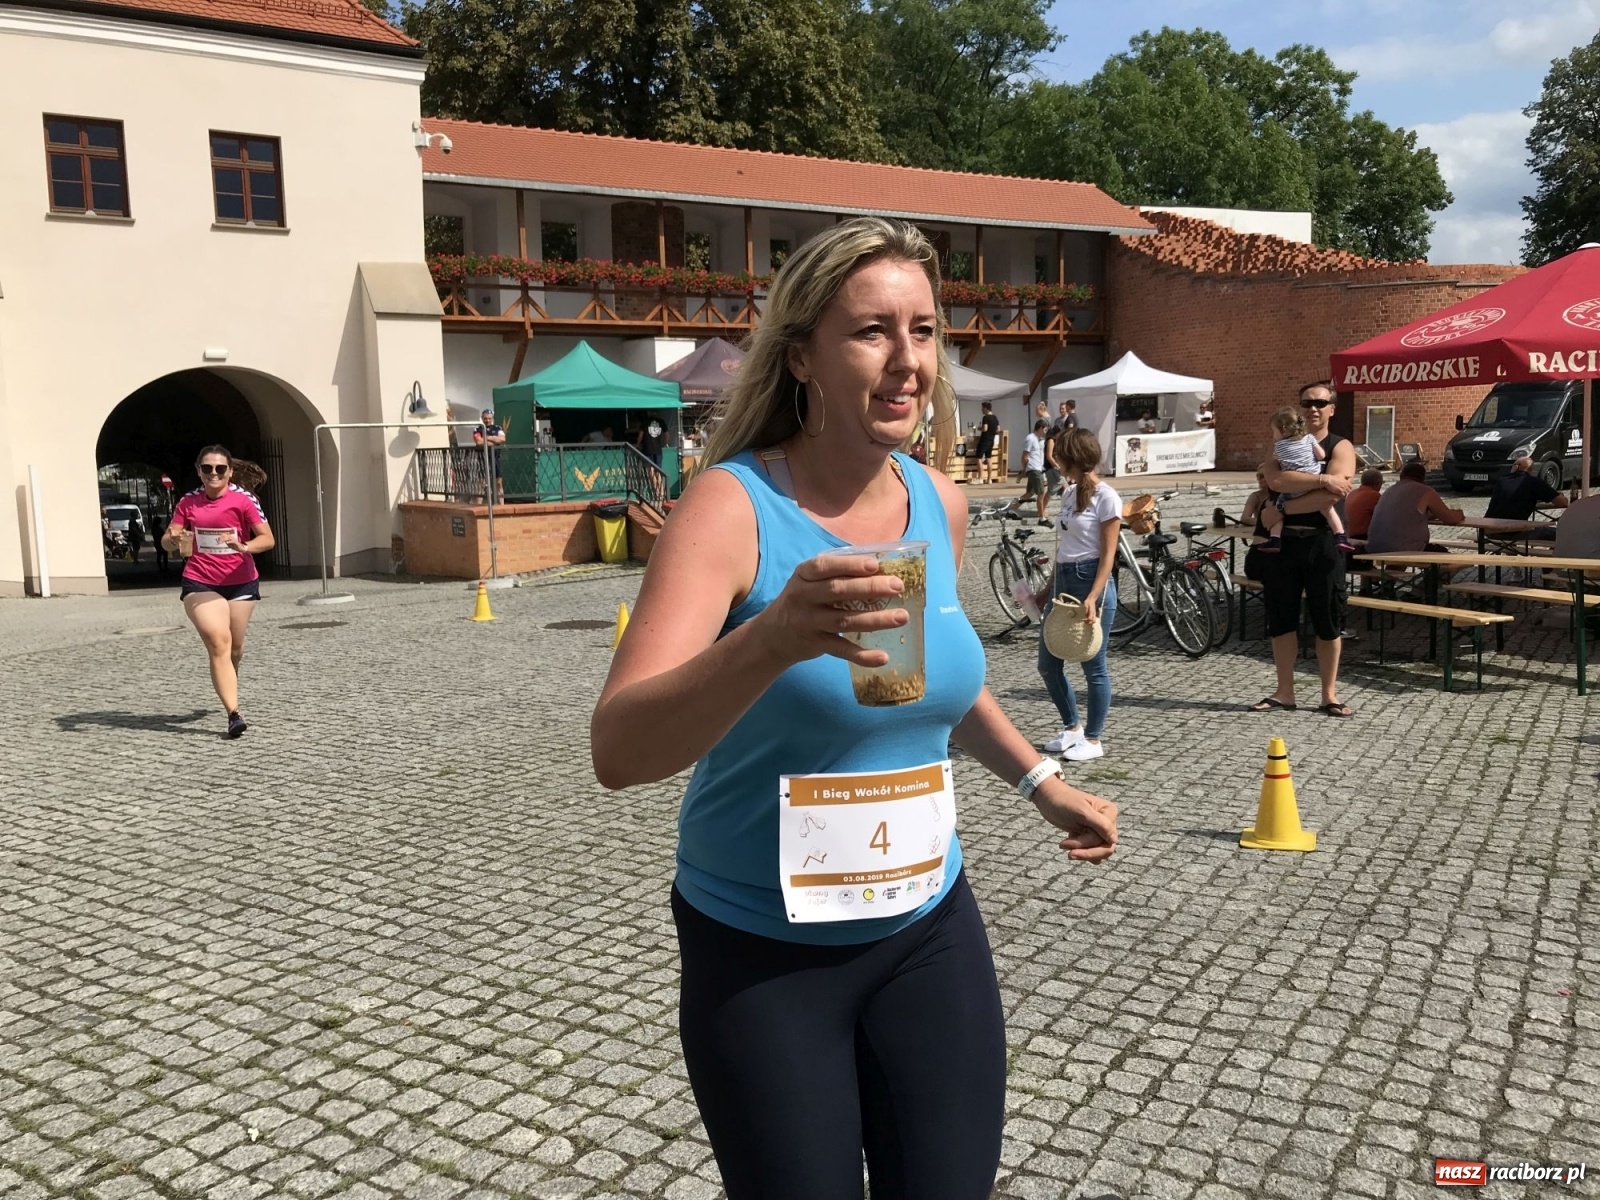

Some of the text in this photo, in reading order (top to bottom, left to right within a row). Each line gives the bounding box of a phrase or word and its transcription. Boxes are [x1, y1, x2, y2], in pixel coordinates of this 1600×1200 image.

[1343, 355, 1480, 385] RACIBORSKIE
[1528, 349, 1600, 374] RACI
[813, 780, 930, 801] I Bieg Wokół Komina
[869, 821, 891, 855] 4
[843, 874, 883, 882] 03.08.2019
